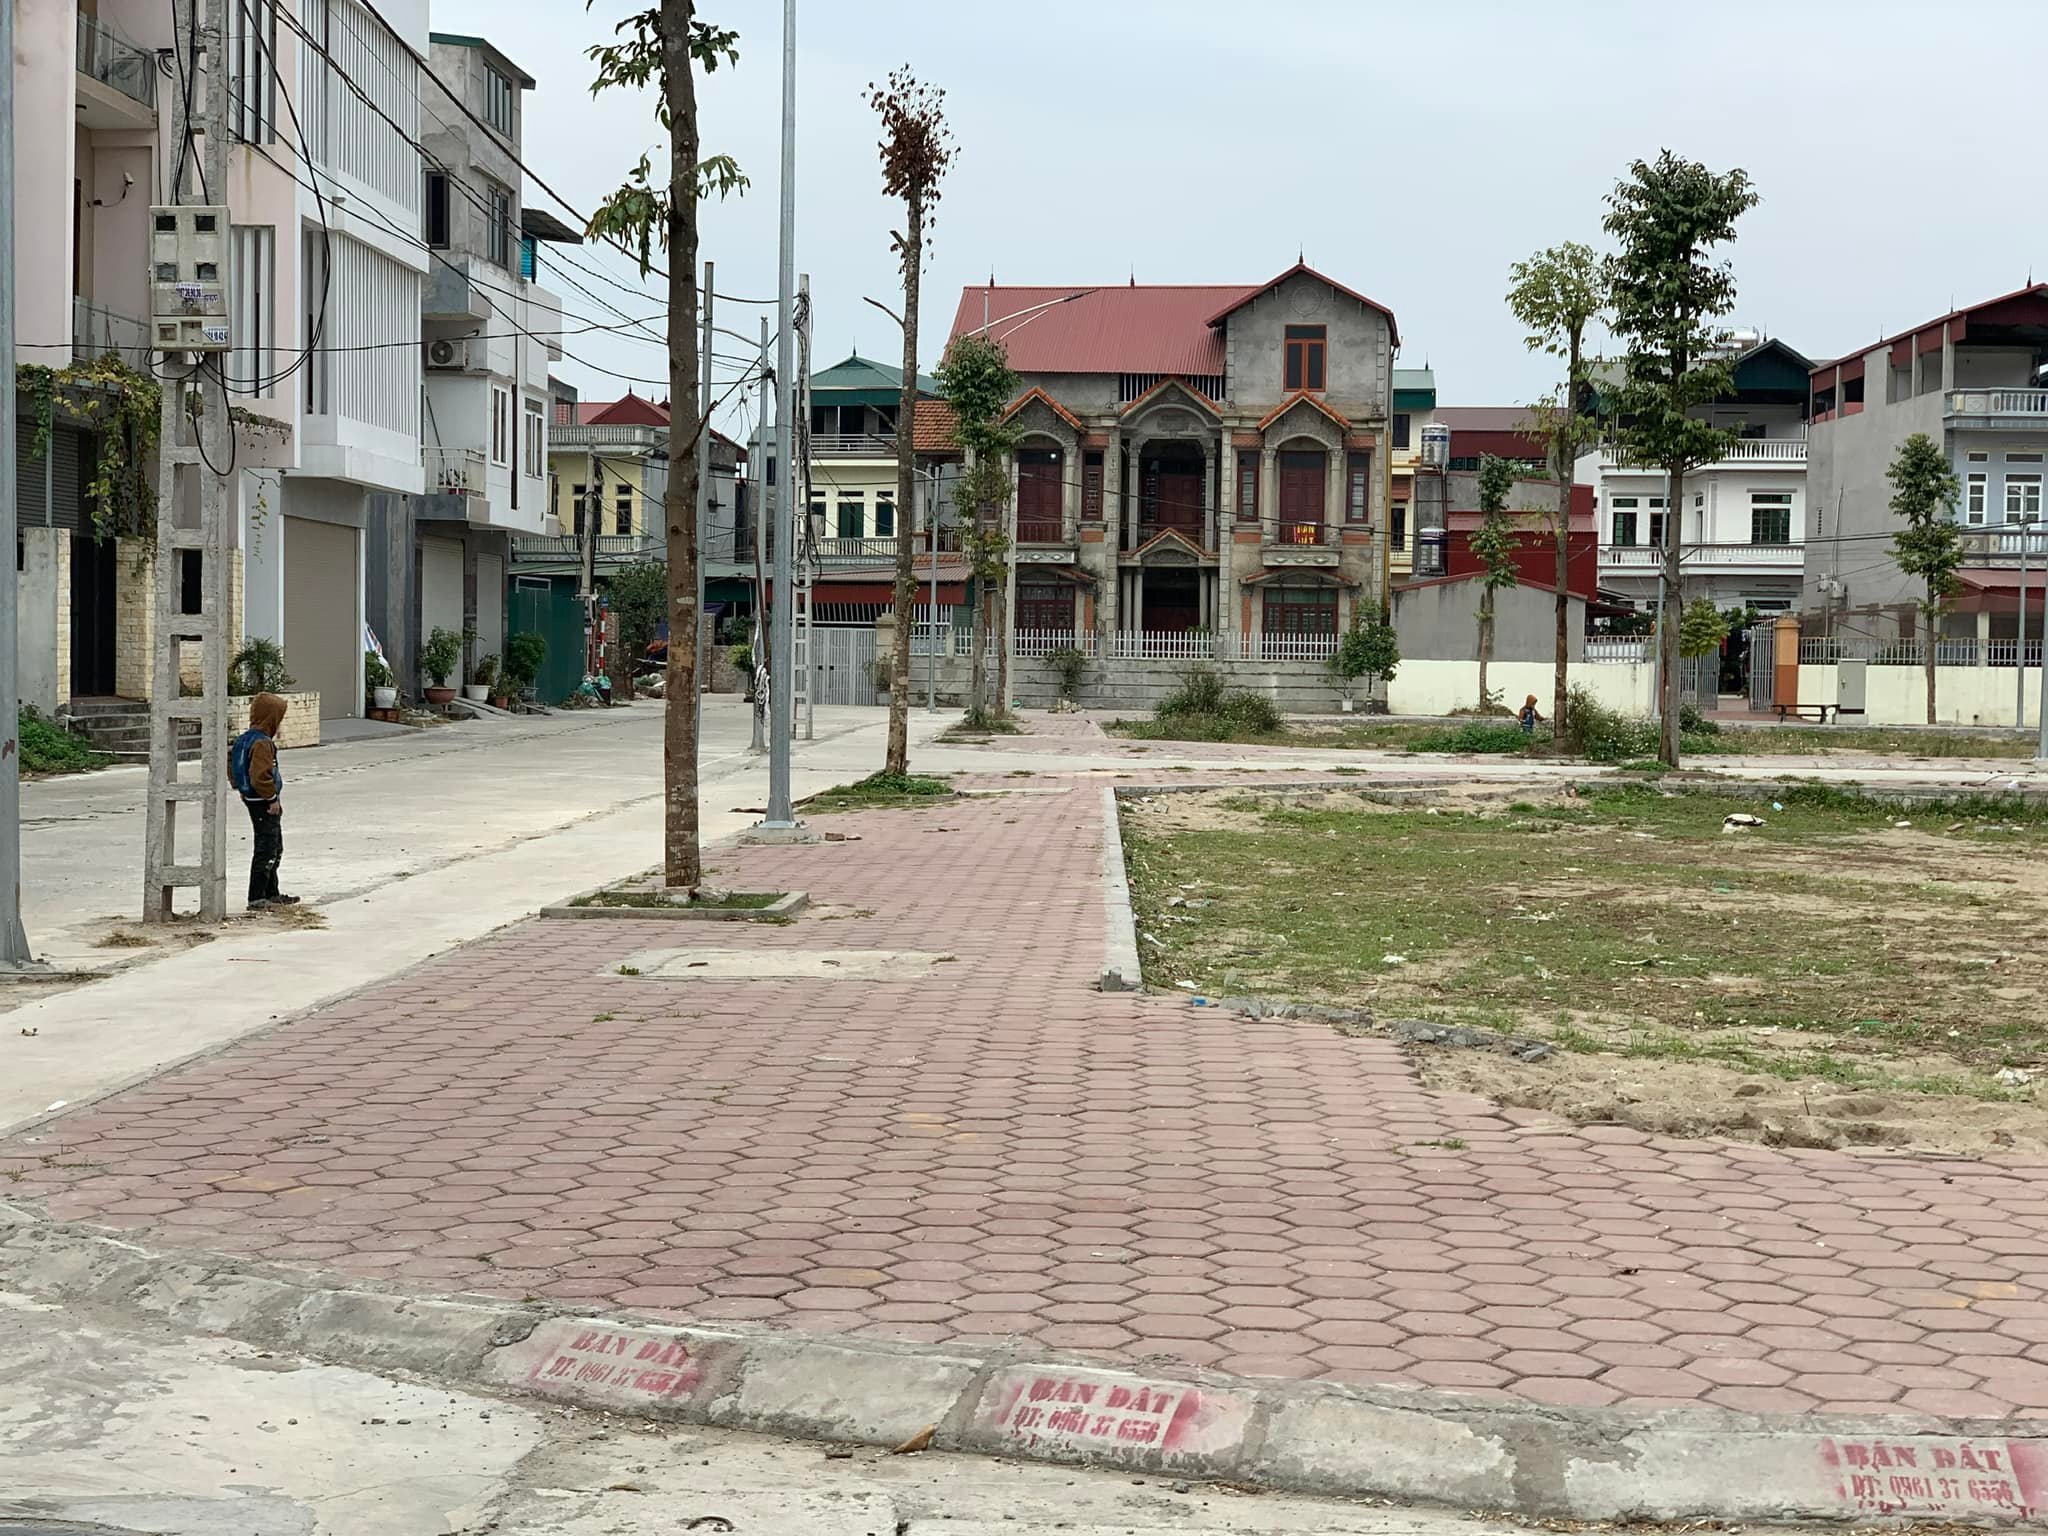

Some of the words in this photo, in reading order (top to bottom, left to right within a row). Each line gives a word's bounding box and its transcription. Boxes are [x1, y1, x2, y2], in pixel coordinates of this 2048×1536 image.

[575, 1361, 615, 1383] 0961
[1028, 1377, 1100, 1404] BÁN
[1047, 1410, 1090, 1434] 0961
[1090, 1416, 1115, 1437] 37
[1117, 1419, 1161, 1443] 6556
[1843, 1440, 1918, 1469] BÁN
[1931, 1440, 2002, 1471] ĐẤT
[1889, 1475, 1934, 1499] 0961
[1939, 1478, 1960, 1499] 37
[1968, 1479, 2013, 1503] 6556
